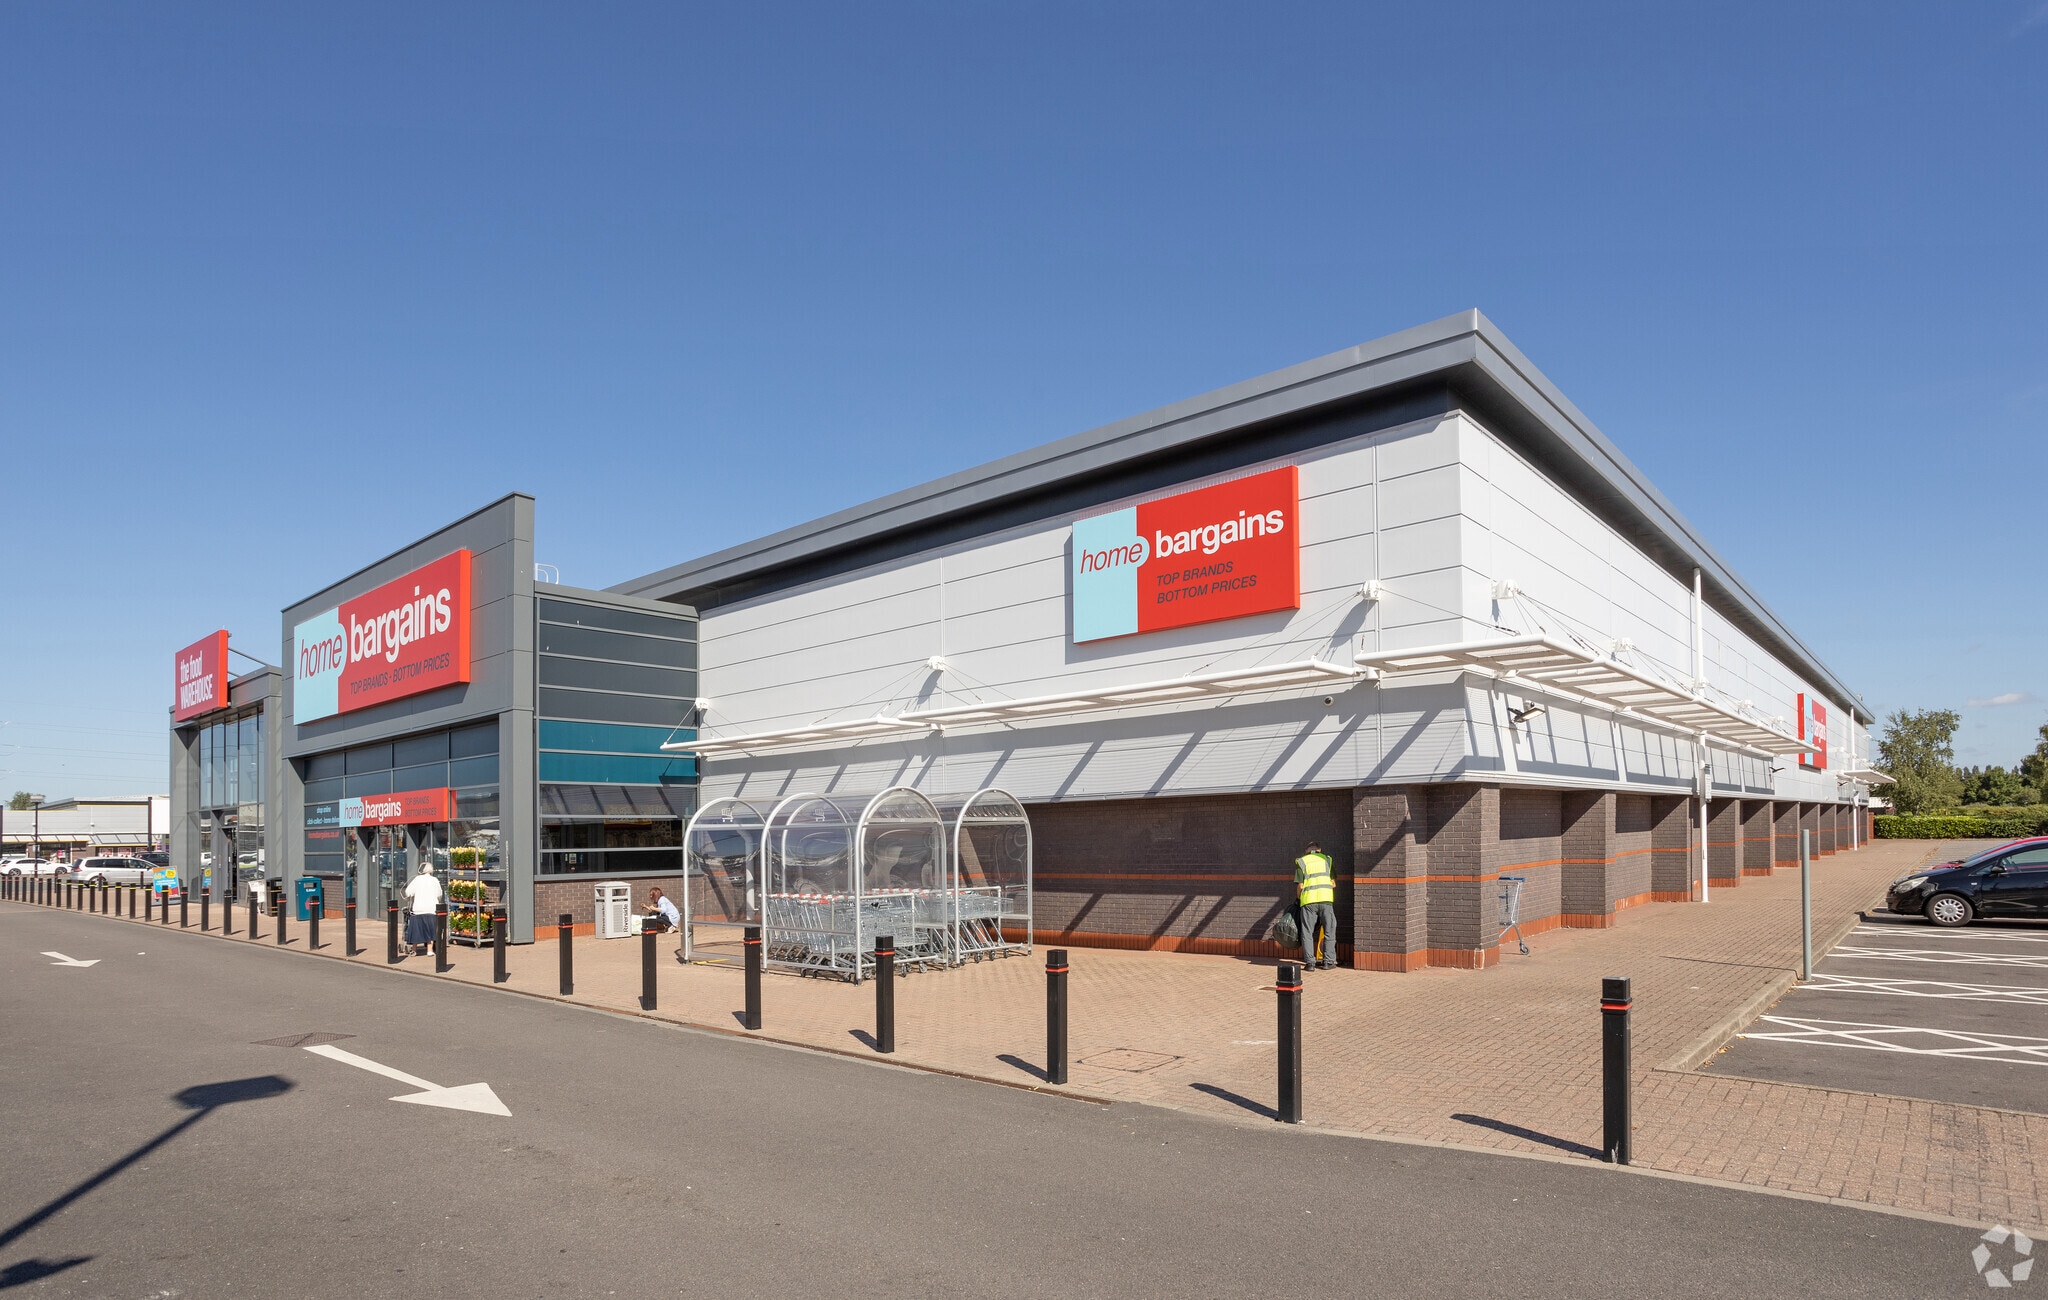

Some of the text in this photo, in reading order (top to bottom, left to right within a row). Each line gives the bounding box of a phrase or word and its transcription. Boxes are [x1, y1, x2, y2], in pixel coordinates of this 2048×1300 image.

[1080, 509, 1284, 574] home bargains
[1156, 561, 1234, 587] TOP BRANDS
[1156, 575, 1258, 604] BOTTOM PRICES
[299, 586, 452, 681] home bargains
[180, 650, 203, 684] the food
[350, 681, 362, 695] TOP
[363, 672, 389, 692] BRANDS
[392, 661, 422, 683] BOTTOM
[423, 652, 451, 673] PRICES
[180, 673, 213, 710] WAREHOUSE
[344, 798, 402, 822] home bargains
